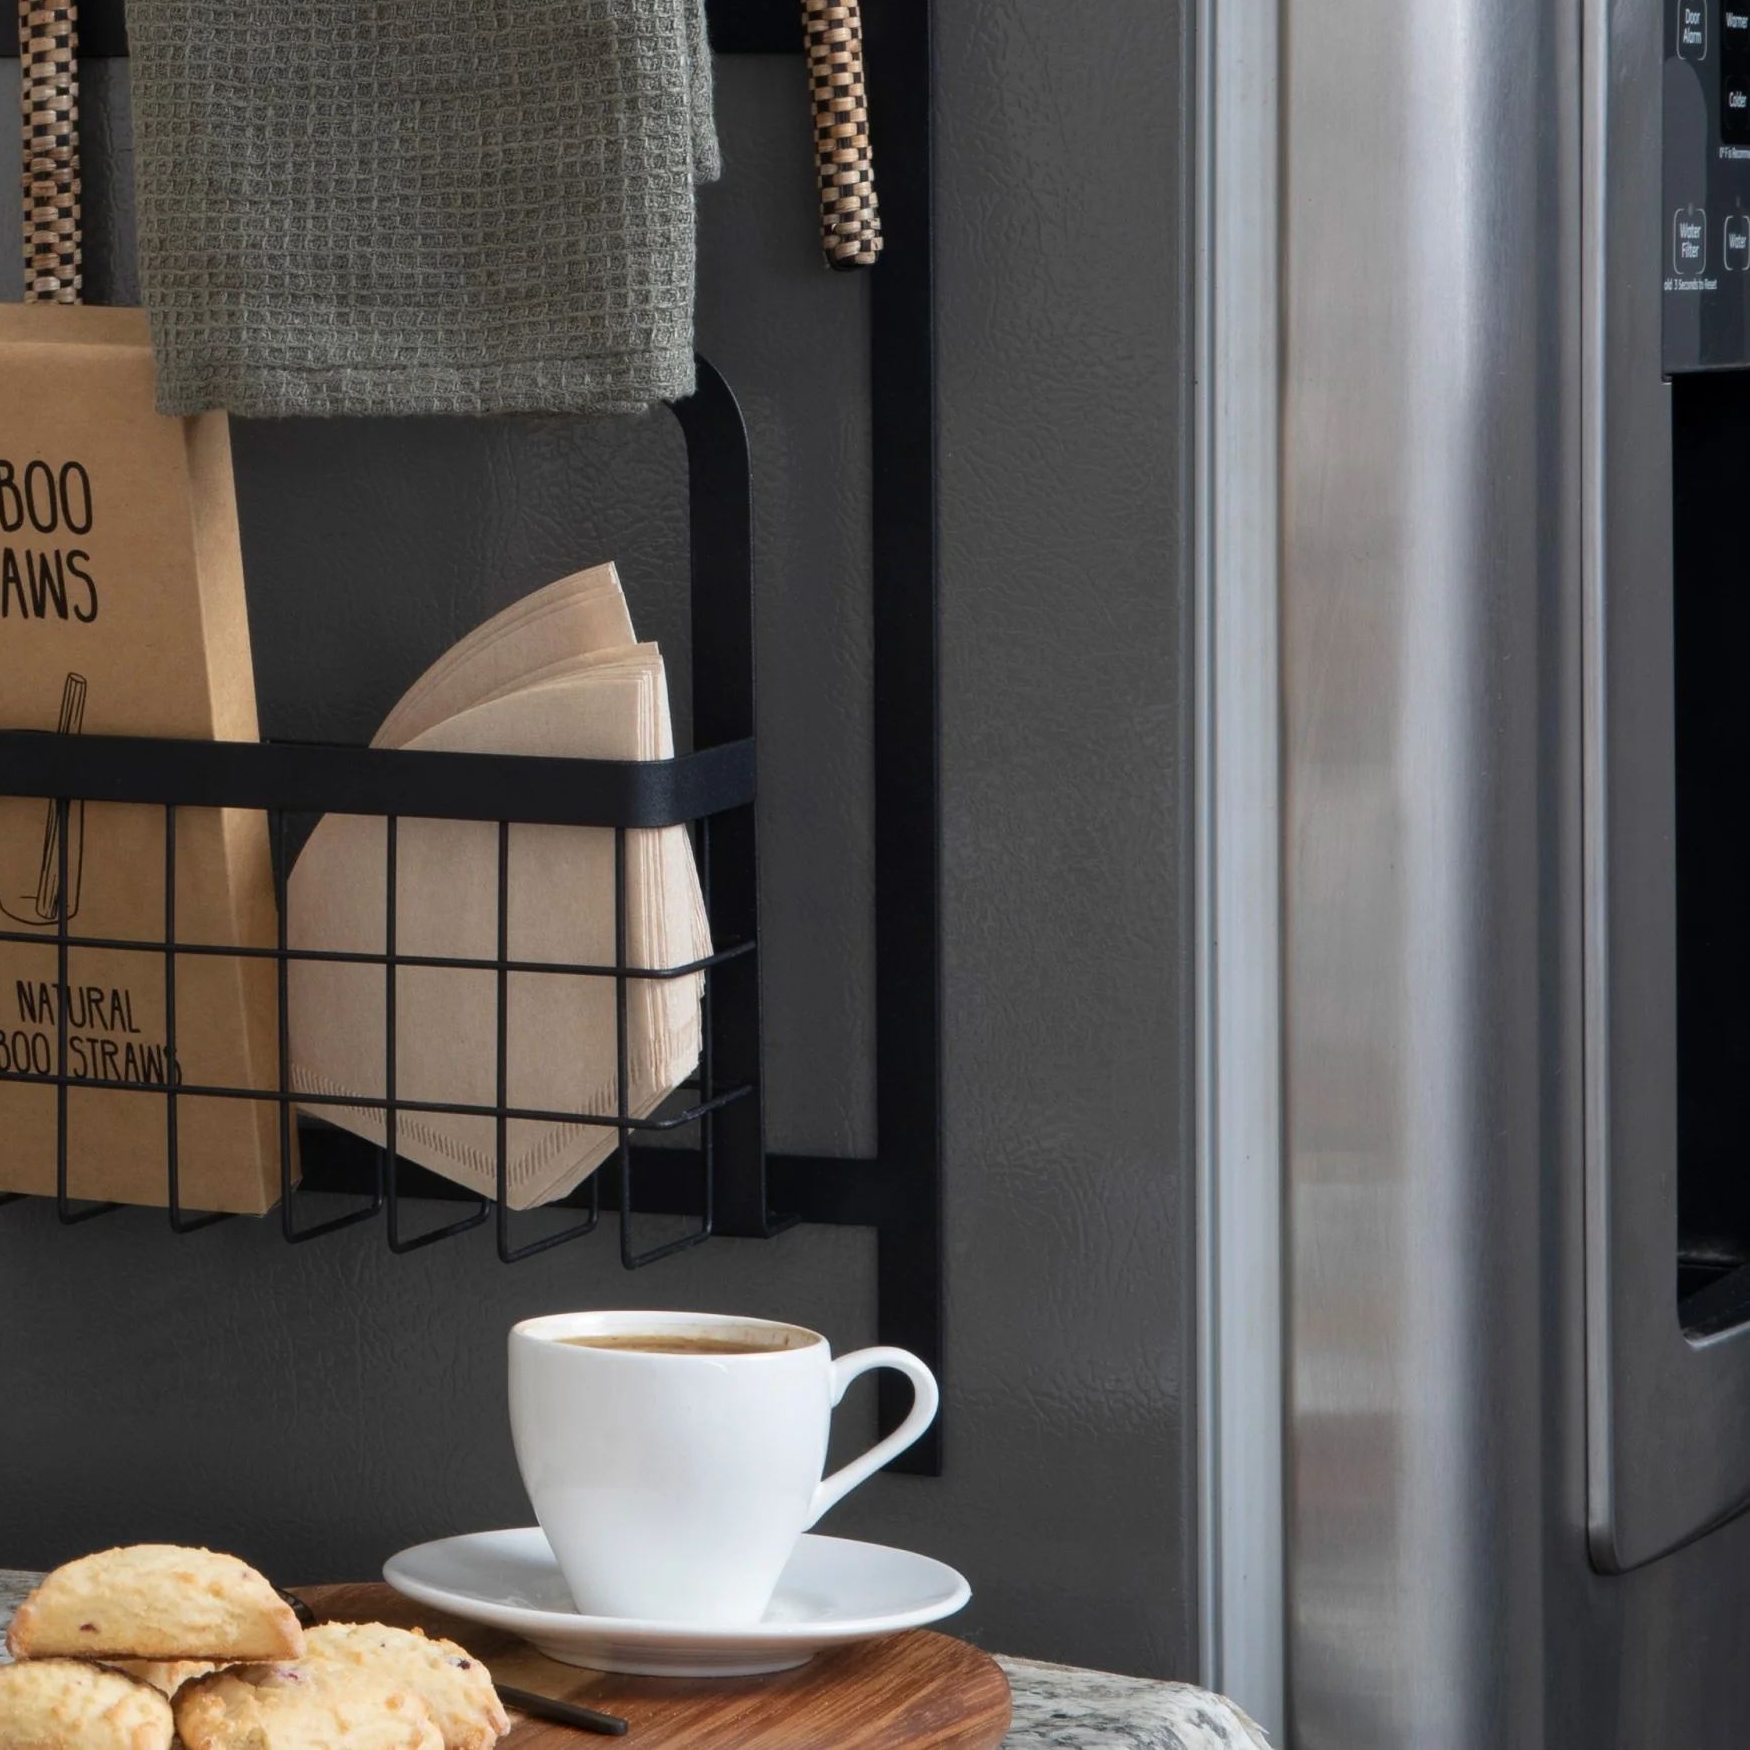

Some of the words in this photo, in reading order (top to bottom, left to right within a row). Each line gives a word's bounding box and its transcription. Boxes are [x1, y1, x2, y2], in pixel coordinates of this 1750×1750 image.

[1685, 8, 1701, 25] Door
[1725, 12, 1749, 29] Warmer
[1683, 27, 1702, 44] Alarm
[1728, 91, 1747, 108] Colder
[1679, 222, 1702, 239] Water
[1681, 241, 1700, 258] Filter
[1729, 234, 1747, 249] Water
